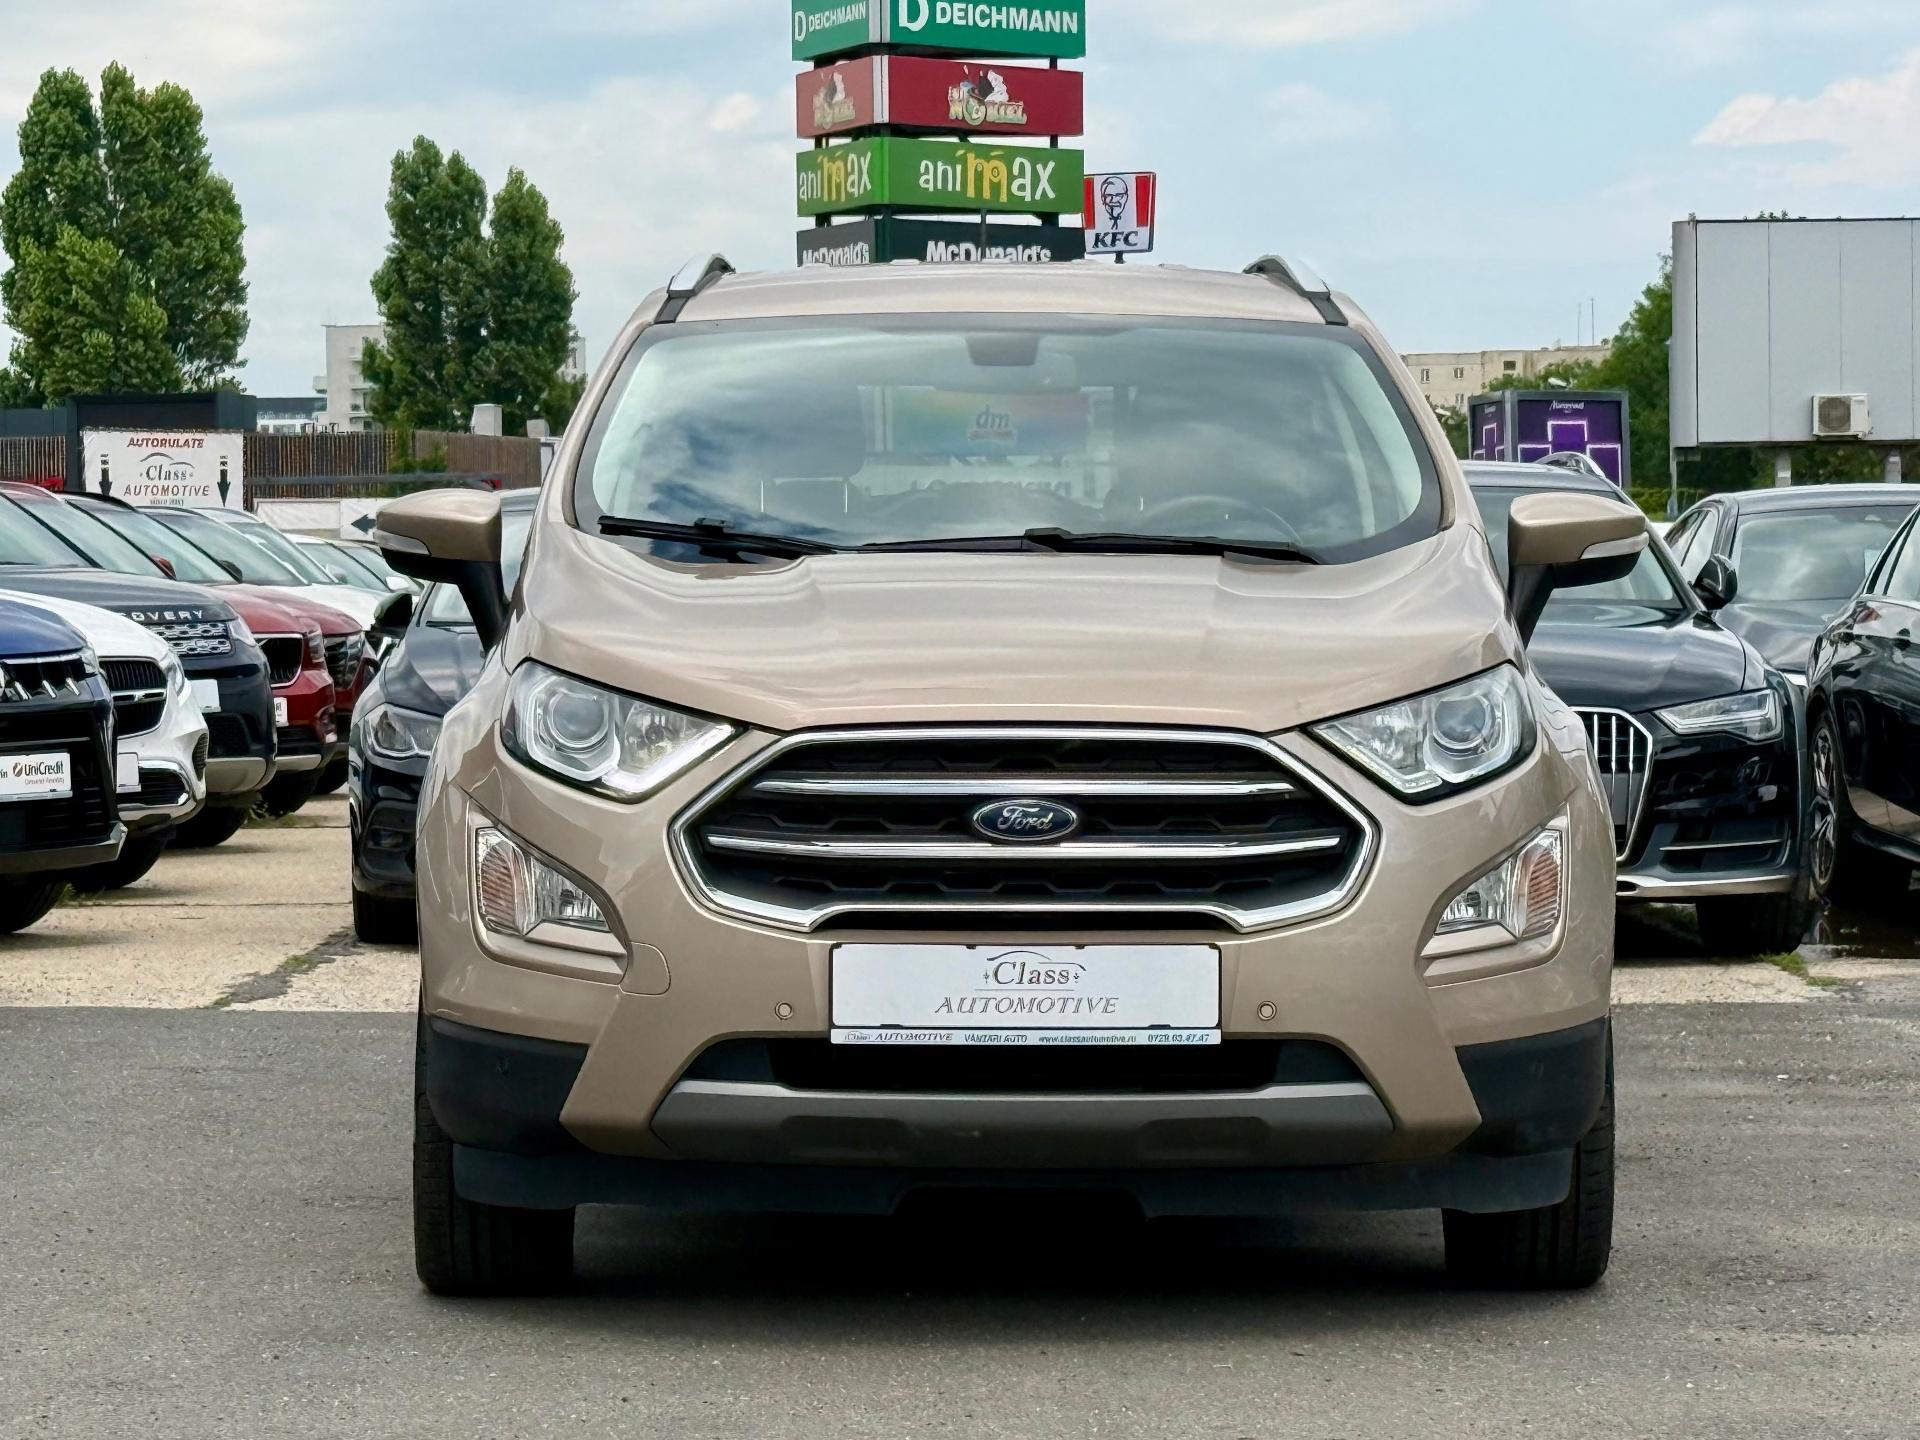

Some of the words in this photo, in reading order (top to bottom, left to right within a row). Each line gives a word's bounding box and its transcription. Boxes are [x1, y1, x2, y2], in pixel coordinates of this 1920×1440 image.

[808, 1, 867, 31] DEICHMANN
[935, 1, 1078, 34] DEICHMANN
[1092, 231, 1139, 249] KFC
[975, 401, 1011, 429] dm
[127, 437, 204, 448] AUTORULATE
[124, 484, 210, 496] AUTOMOTIVE
[997, 805, 1054, 830] Ford
[993, 961, 1071, 985] Class
[934, 996, 1120, 1014] AUTOMOTIVE
[875, 1032, 953, 1041] AUTOMOTIVE
